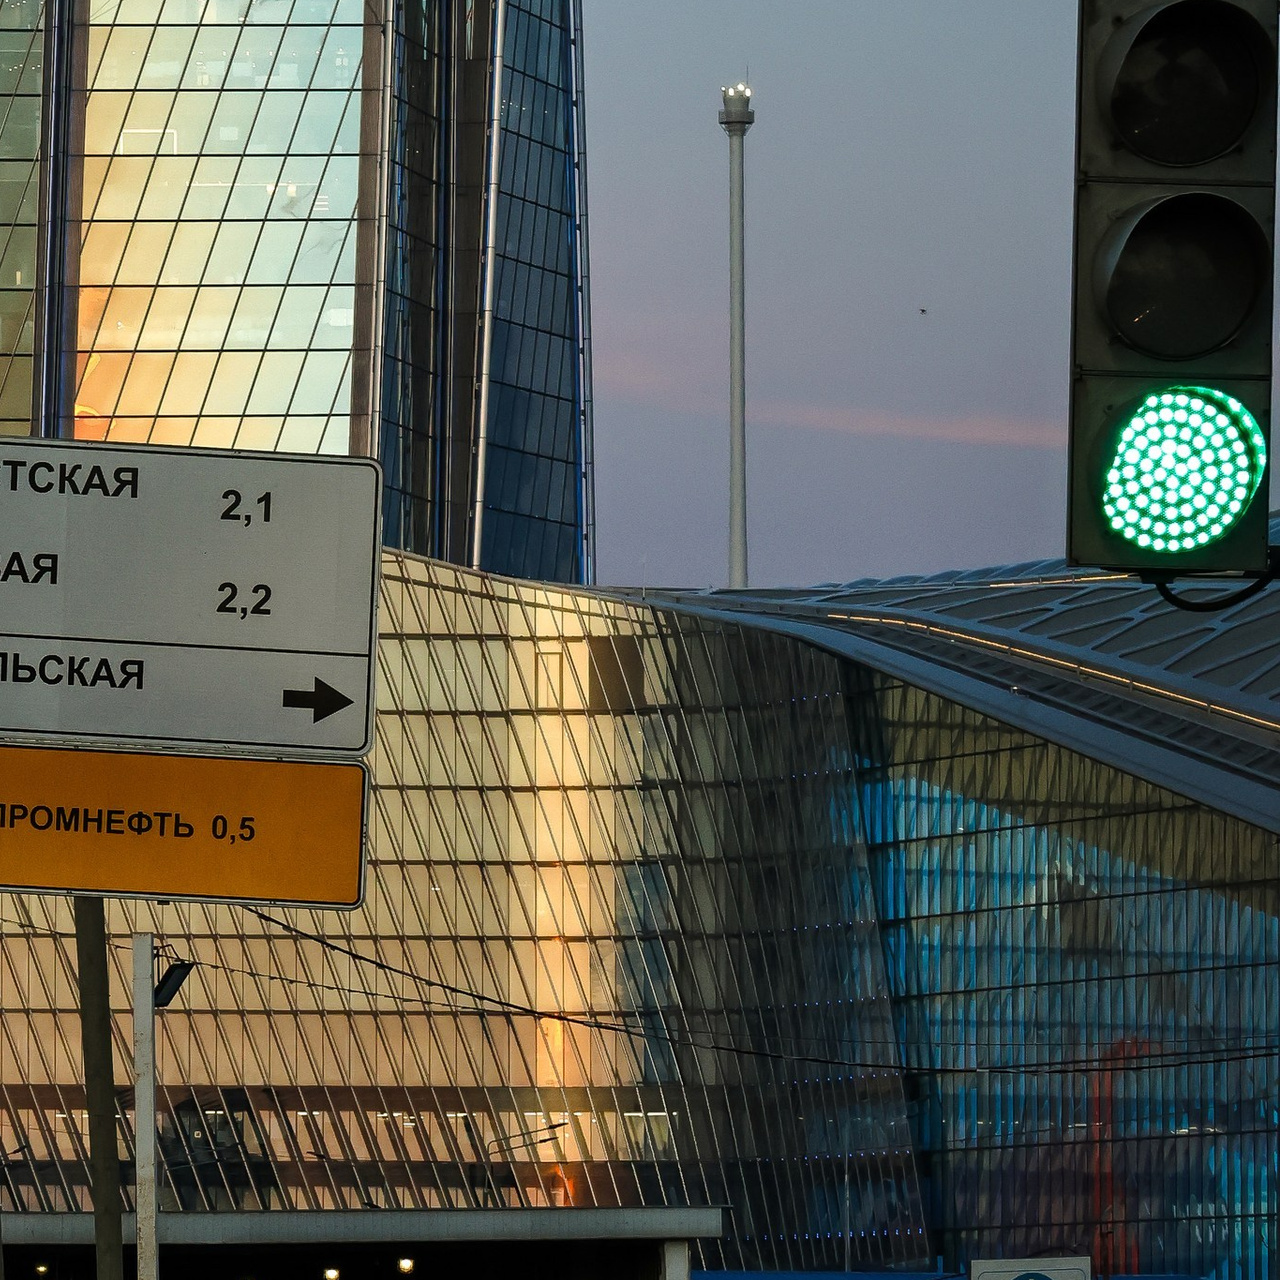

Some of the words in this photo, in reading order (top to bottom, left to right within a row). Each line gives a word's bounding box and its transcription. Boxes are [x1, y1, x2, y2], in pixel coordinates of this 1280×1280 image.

[220, 488, 273, 529] 2,1
[216, 582, 273, 620] 2,2
[211, 815, 256, 844] 0,5
